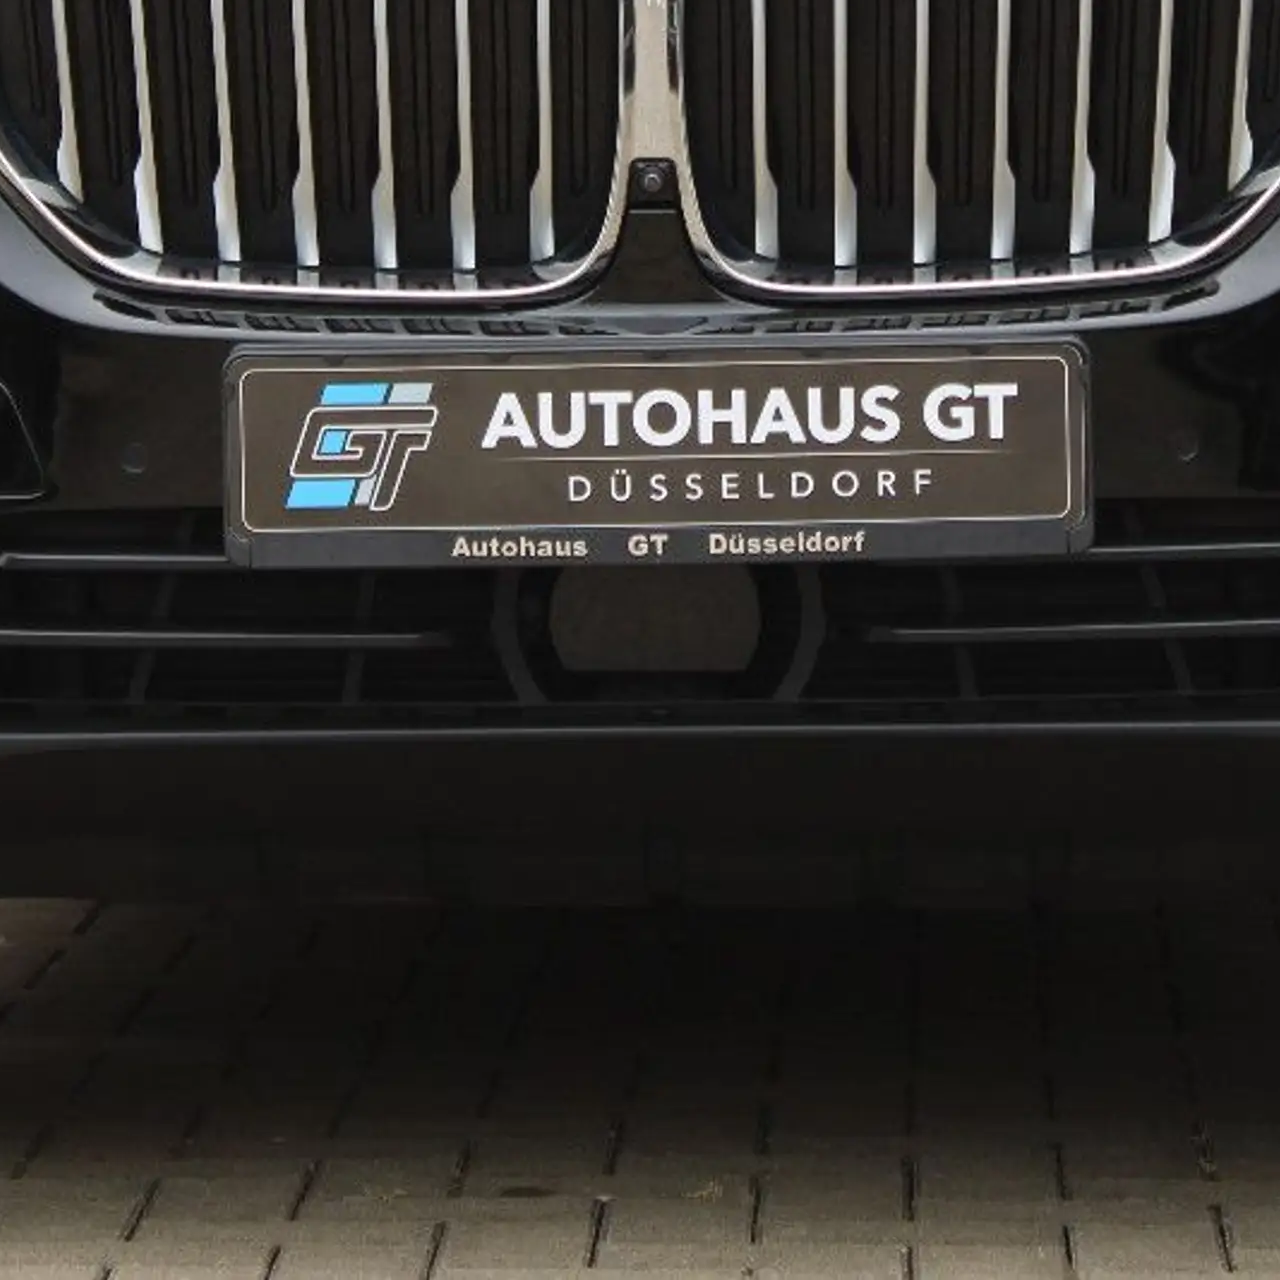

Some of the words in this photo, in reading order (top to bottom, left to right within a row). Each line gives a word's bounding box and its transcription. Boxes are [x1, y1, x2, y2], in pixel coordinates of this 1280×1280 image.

[480, 384, 902, 449] AUTOHAUS
[922, 382, 1019, 442] GT
[567, 468, 932, 503] DÜSSELDORF
[451, 534, 589, 558] Autohaus
[627, 533, 669, 557] GT
[708, 530, 867, 556] Düsseldorf
